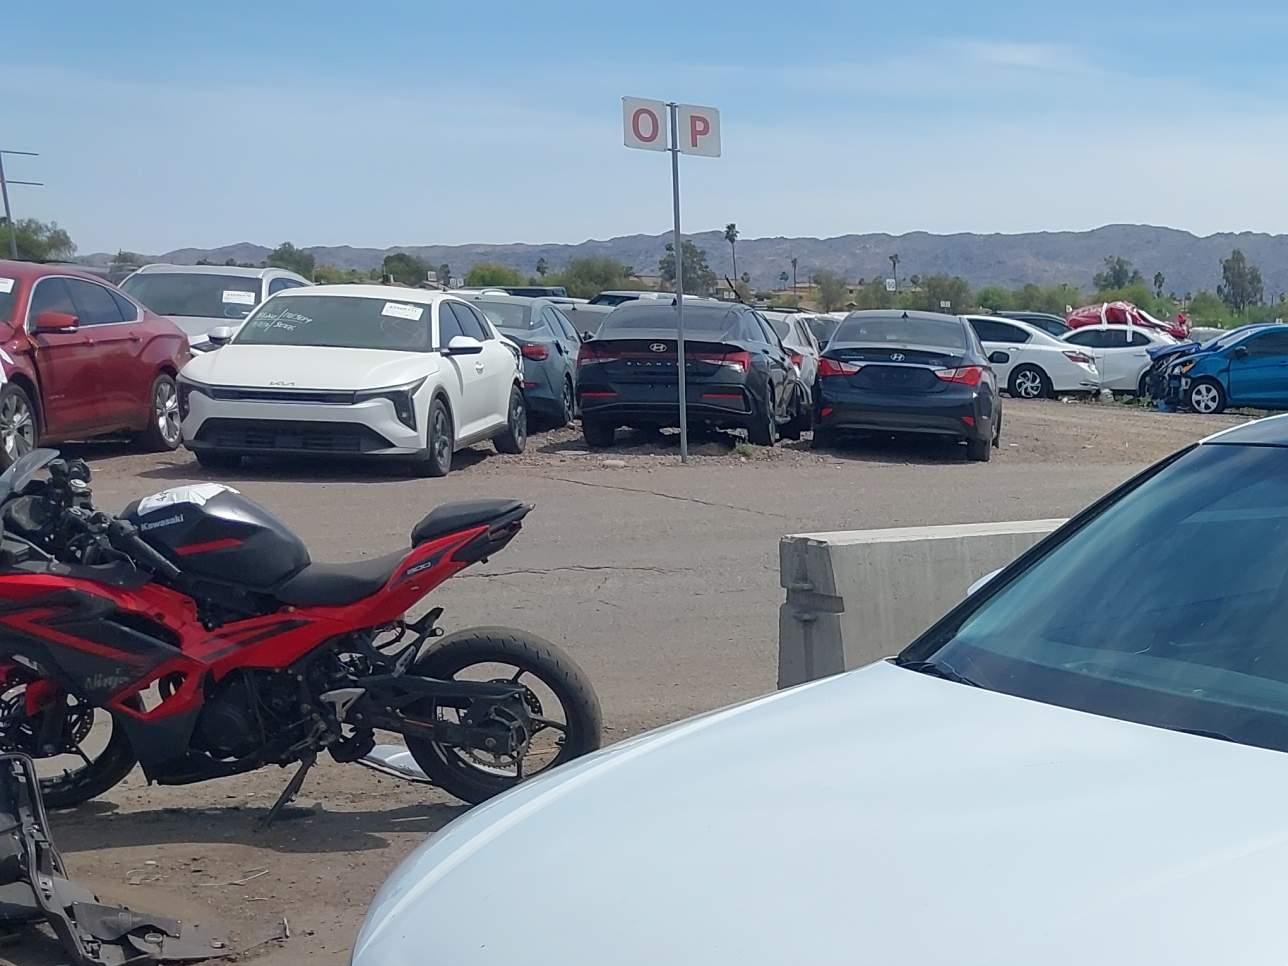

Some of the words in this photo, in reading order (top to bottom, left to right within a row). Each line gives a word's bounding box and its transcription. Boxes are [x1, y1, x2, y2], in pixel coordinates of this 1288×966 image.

[632, 107, 659, 143] O
[690, 115, 710, 148] P
[140, 513, 184, 531] Kawasaki
